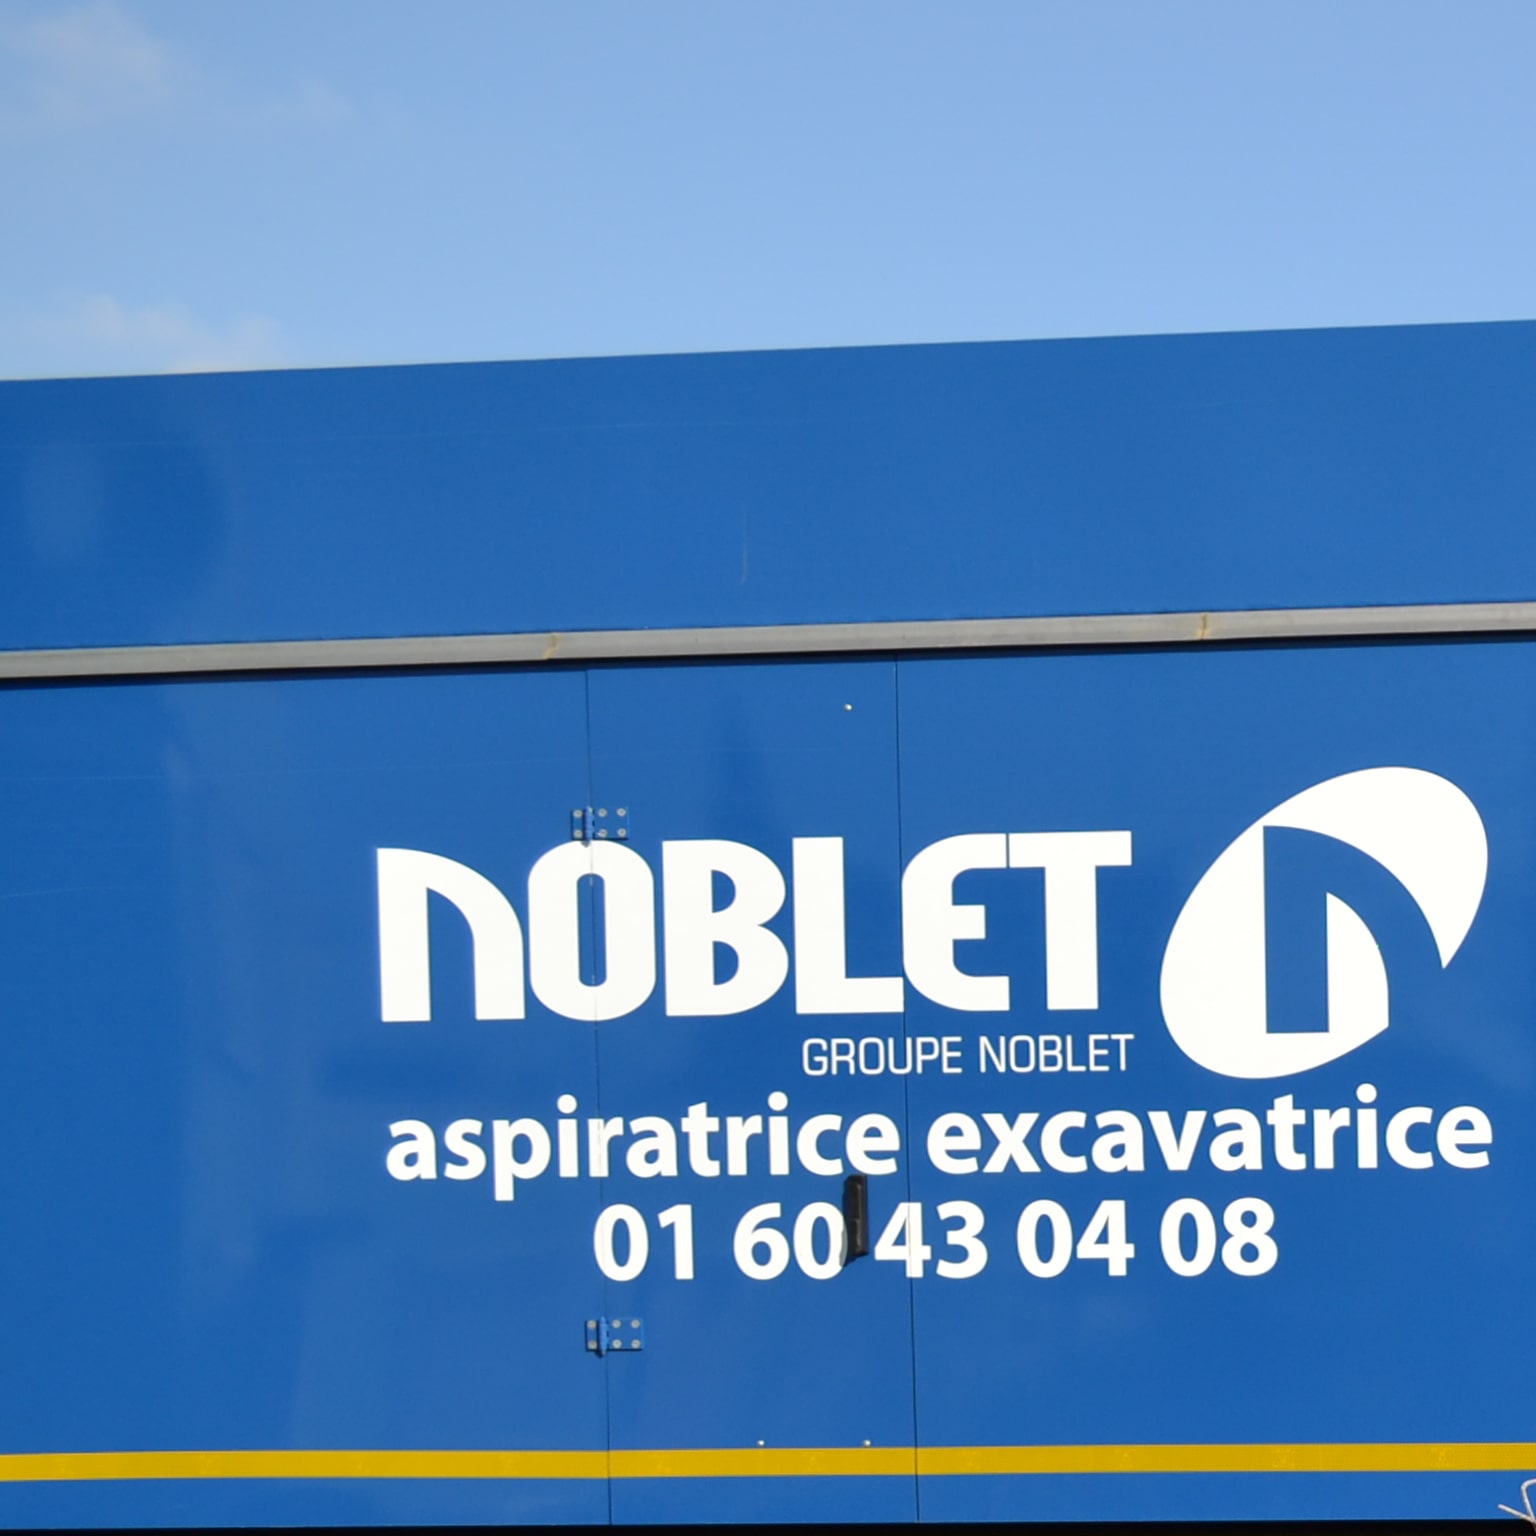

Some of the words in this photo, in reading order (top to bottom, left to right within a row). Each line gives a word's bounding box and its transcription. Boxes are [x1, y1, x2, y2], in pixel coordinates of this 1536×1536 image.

[802, 1036, 963, 1076] GROUPE
[979, 1033, 1135, 1073] NOBLET
[386, 1091, 900, 1202] aspiratrice
[926, 1083, 1493, 1175] excavatrice
[593, 1203, 694, 1282] 01
[733, 1201, 845, 1281] 60
[874, 1200, 988, 1279] 43
[1016, 1199, 1135, 1278] 04
[1160, 1197, 1278, 1277] 08
